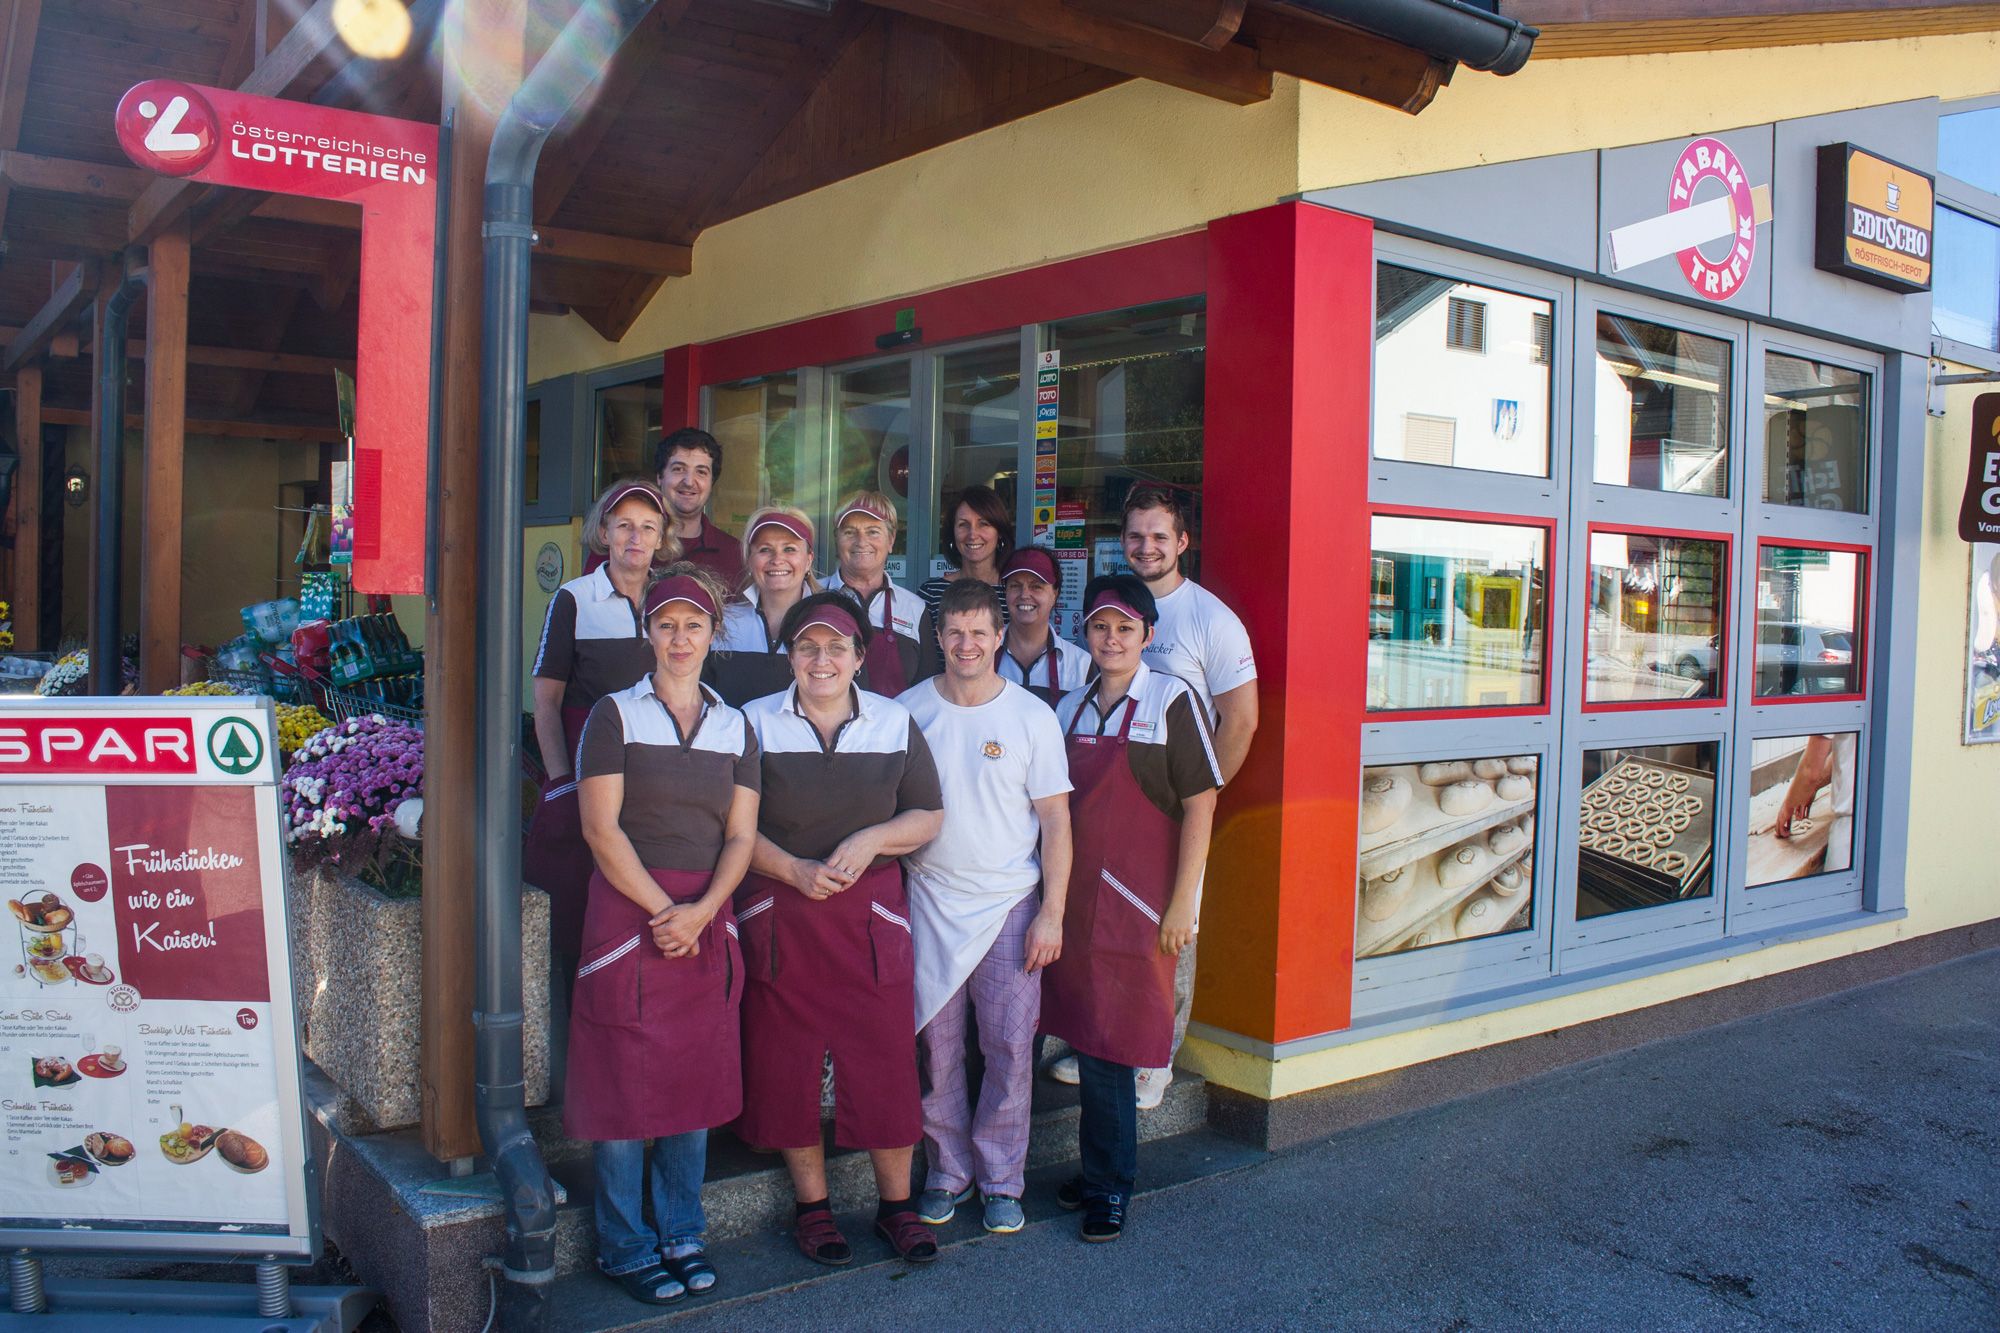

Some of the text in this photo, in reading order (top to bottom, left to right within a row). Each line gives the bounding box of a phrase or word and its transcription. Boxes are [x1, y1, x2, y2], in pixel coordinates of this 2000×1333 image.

[231, 121, 427, 165] österreichische
[231, 139, 426, 186] LOTTERIEN
[1673, 146, 1744, 200] TABAK
[1691, 214, 1752, 294] TRAFIK
[1854, 247, 1923, 278] RÖSTFRISCH-DEPOT
[1039, 390, 1057, 401] TOTO
[1038, 407, 1057, 418] JOKER
[1983, 452, 2000, 483] E
[114, 843, 243, 876] Frühstücken
[128, 889, 194, 910] wie ein
[133, 921, 217, 954] Kaiser!
[237, 1013, 256, 1025] Tipp
